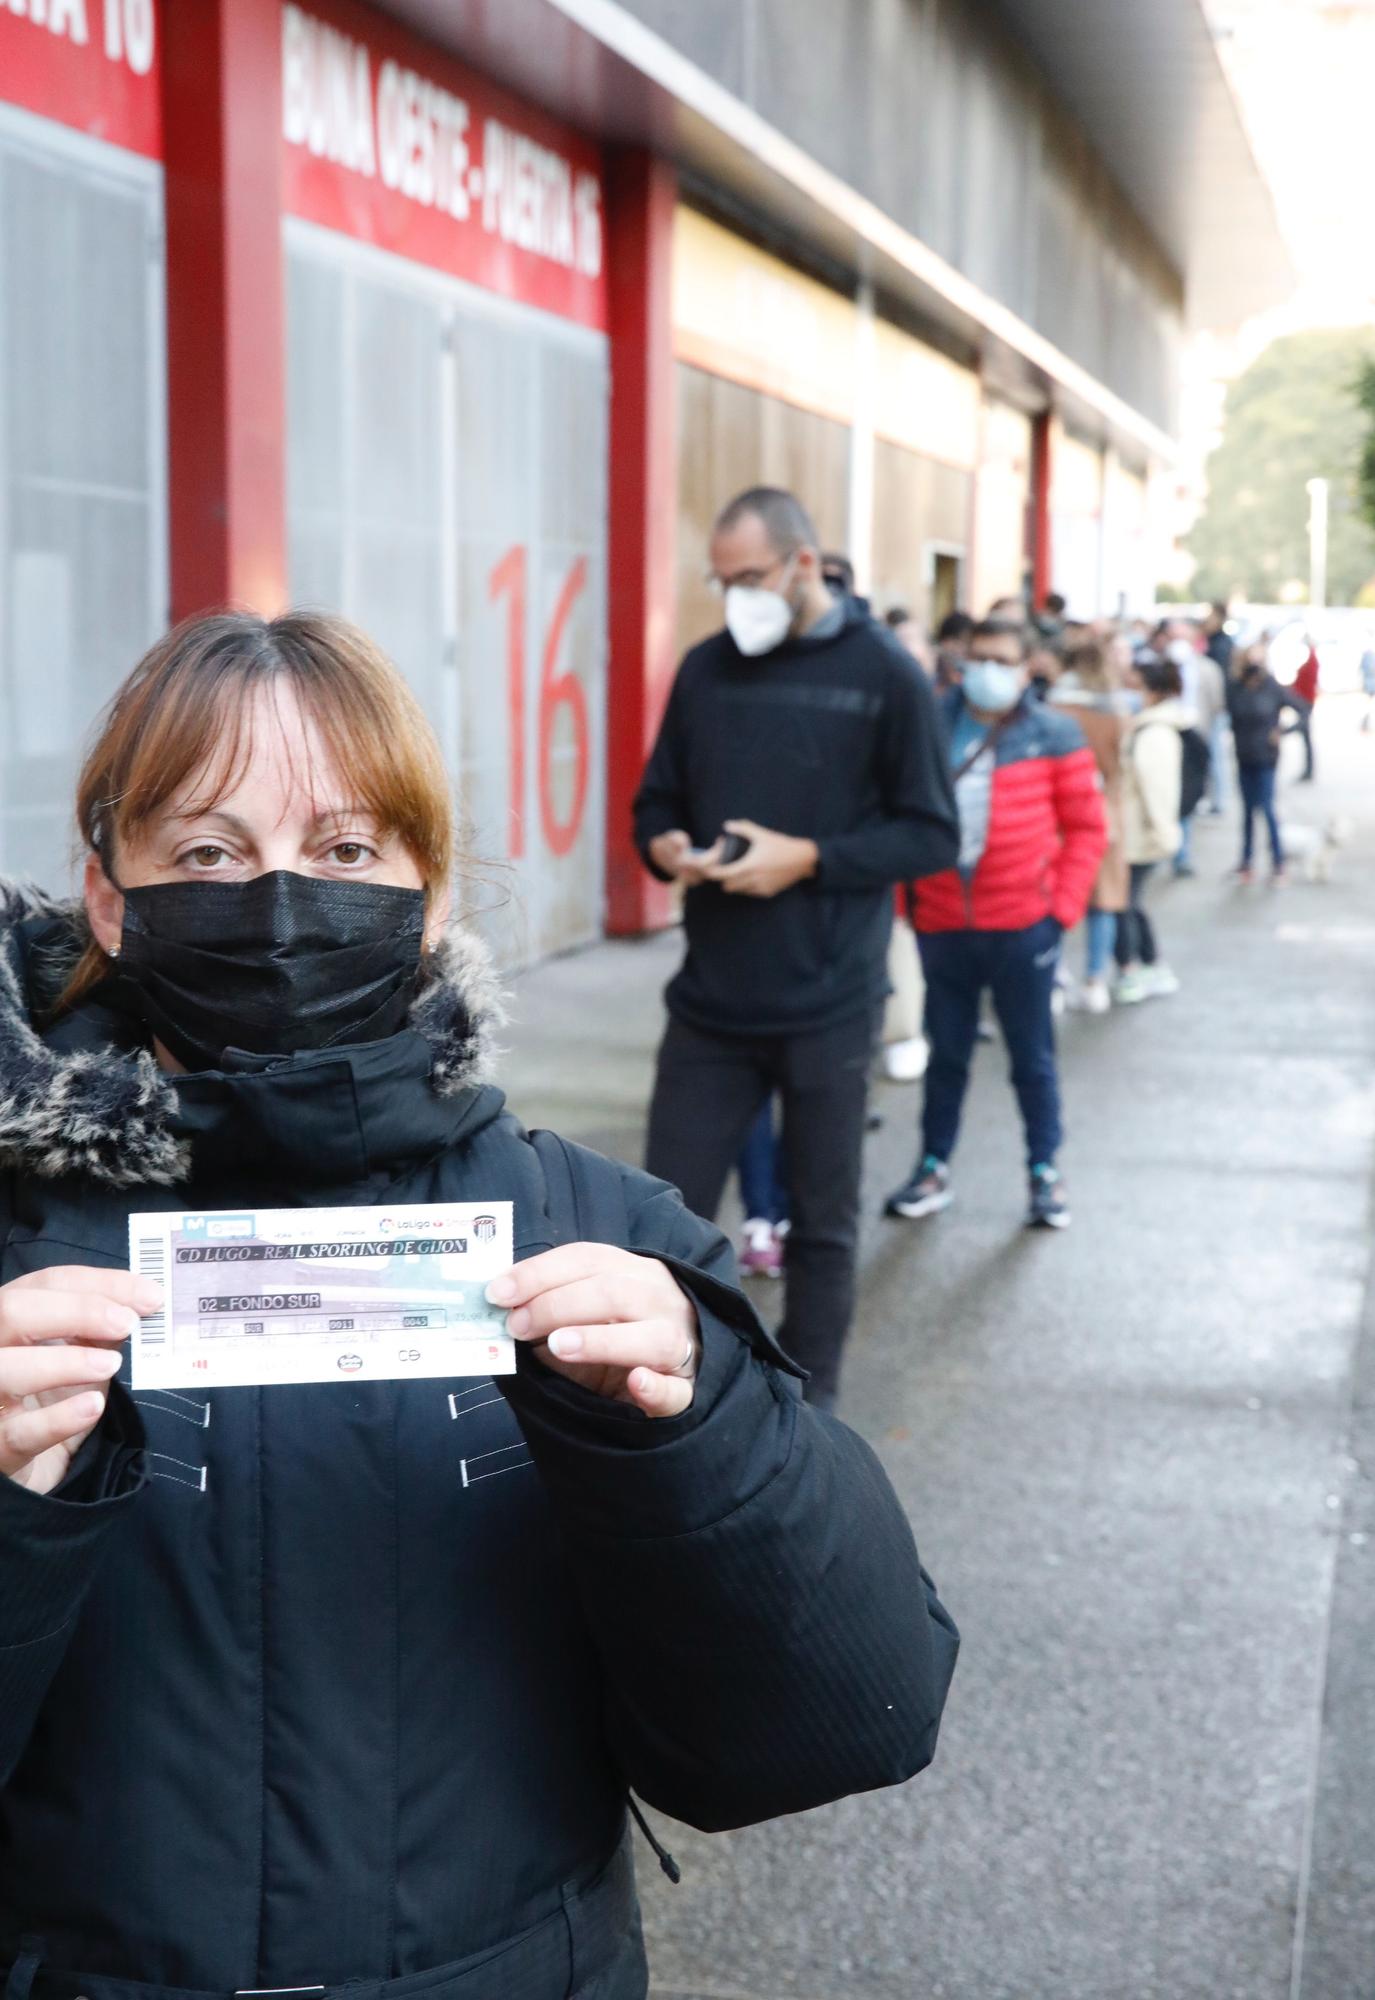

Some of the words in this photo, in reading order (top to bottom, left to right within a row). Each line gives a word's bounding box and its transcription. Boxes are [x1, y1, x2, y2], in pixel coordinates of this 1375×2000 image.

[488, 543, 588, 857] 16
[176, 1249, 200, 1263] CD
[204, 1247, 250, 1261] LUGO
[263, 1245, 304, 1259] REAL
[309, 1242, 388, 1257] SPORTING
[392, 1240, 414, 1253] DE
[200, 1299, 217, 1312] 02
[229, 1297, 285, 1311] FONDO
[288, 1295, 320, 1308] SUR
